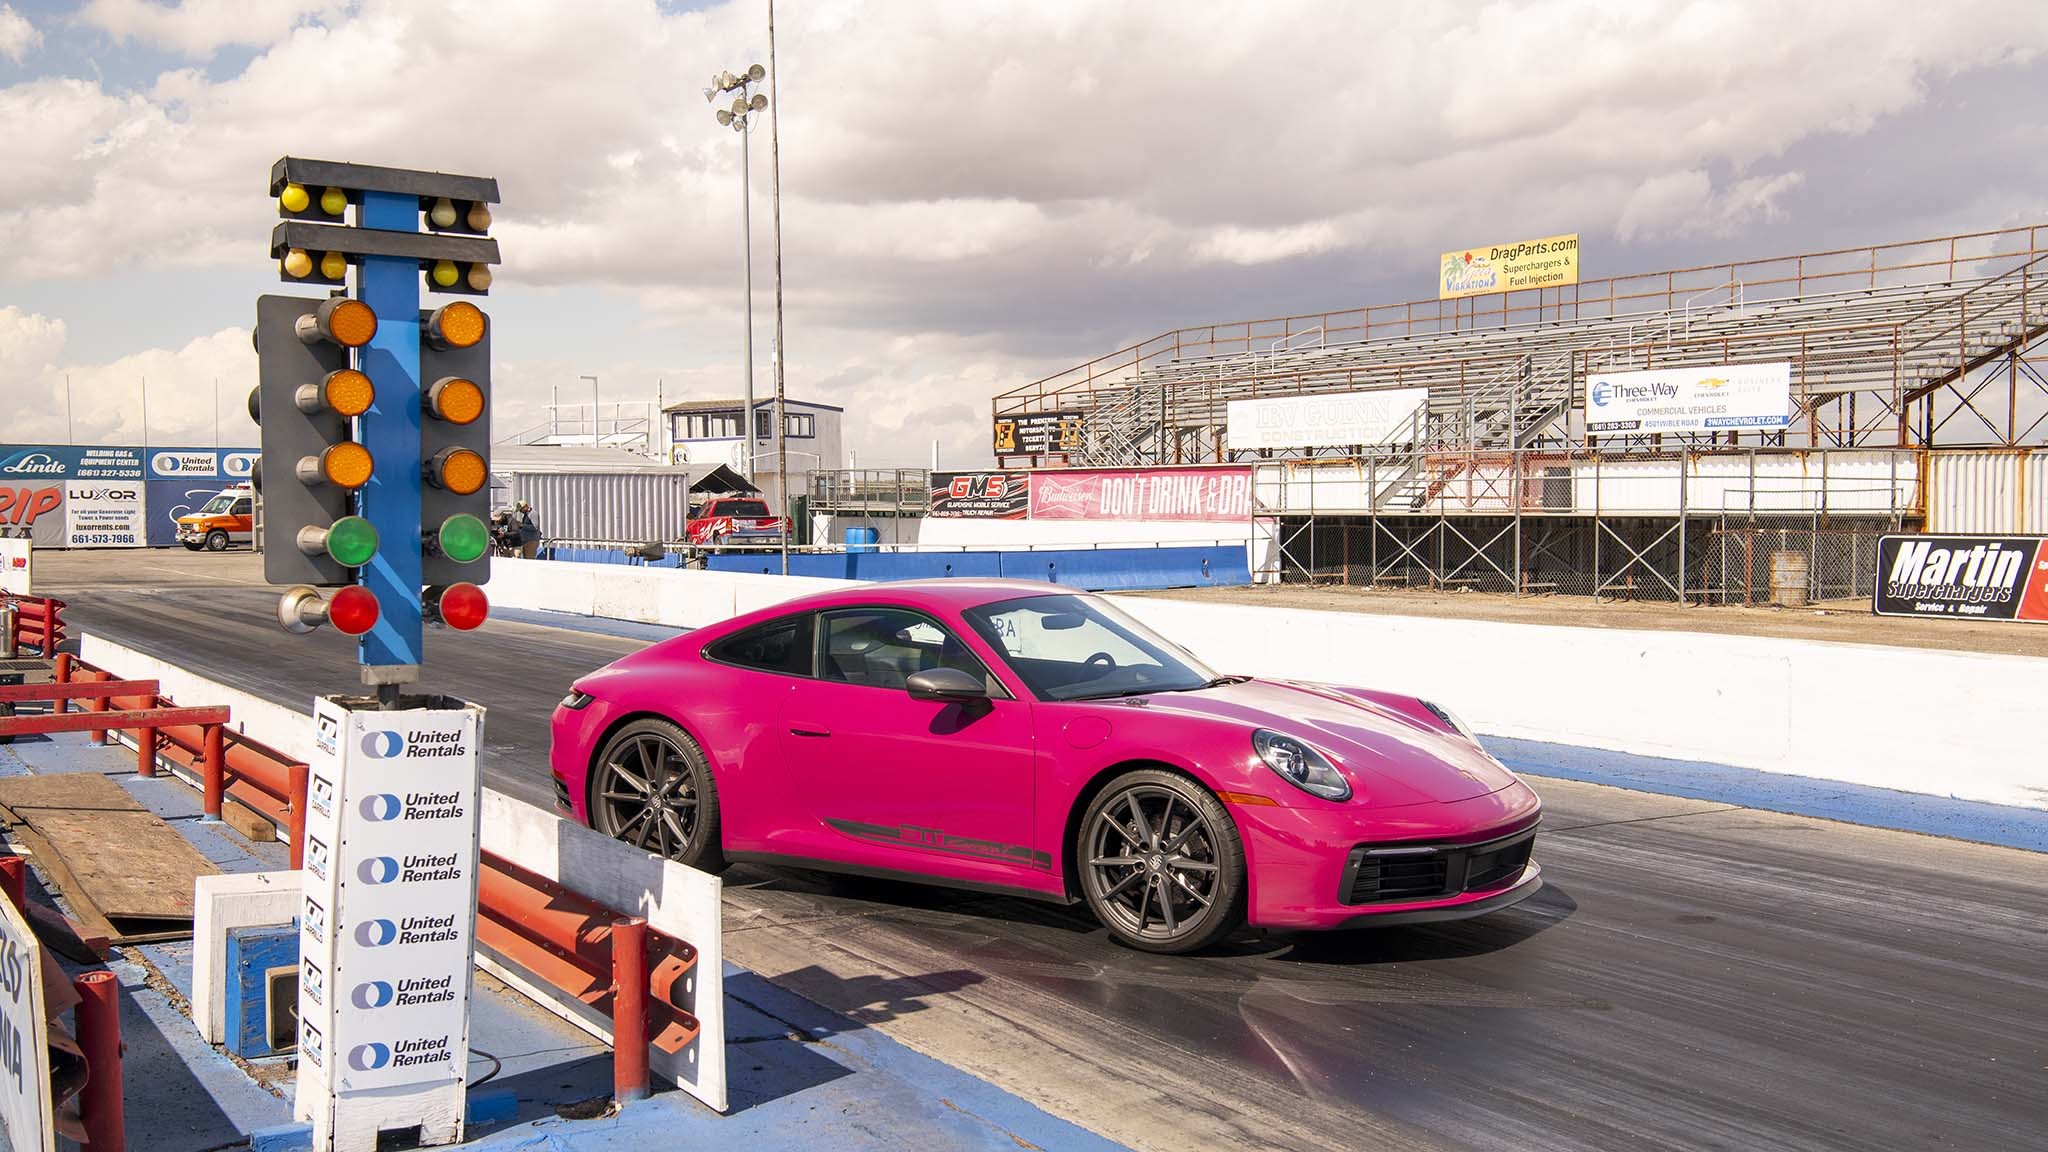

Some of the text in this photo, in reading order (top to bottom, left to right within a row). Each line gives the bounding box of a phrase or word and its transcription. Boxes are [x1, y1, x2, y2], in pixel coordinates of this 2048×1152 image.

[1490, 239, 1577, 261] DragParts.com
[1503, 259, 1562, 274] Superchargers
[1564, 257, 1570, 265] &
[1510, 272, 1563, 287] Fuel Injection
[1612, 381, 1679, 399] Three-Way
[1637, 404, 1727, 417] COMMERCIAL VEHICLES
[1707, 416, 1783, 427] 3WAYCHEVROLET.COM
[3, 453, 66, 473] Linde
[951, 475, 1005, 498] GMS
[1100, 473, 1147, 515] DON'T
[1149, 476, 1204, 514] DRINK
[1206, 477, 1217, 513] &
[69, 488, 137, 502] LUXOR
[1039, 486, 1092, 504] Budweiser
[76, 523, 130, 531] luxorrents.com
[72, 534, 135, 544] 661-573-7966
[1888, 541, 2024, 588] Martin
[1886, 580, 2013, 603] Superchargers
[1915, 601, 1987, 614] Service & Repair
[408, 730, 462, 744] United
[406, 744, 465, 758] Rentals
[405, 791, 460, 806] United
[404, 806, 463, 820] Rentals
[403, 853, 457, 868] United
[402, 868, 461, 883] Rentals
[400, 914, 454, 930] United
[399, 929, 458, 944] Rentals
[397, 975, 451, 992] United
[396, 990, 455, 1007] Rentals
[394, 1035, 448, 1053] United
[393, 1050, 451, 1068] Rentals
